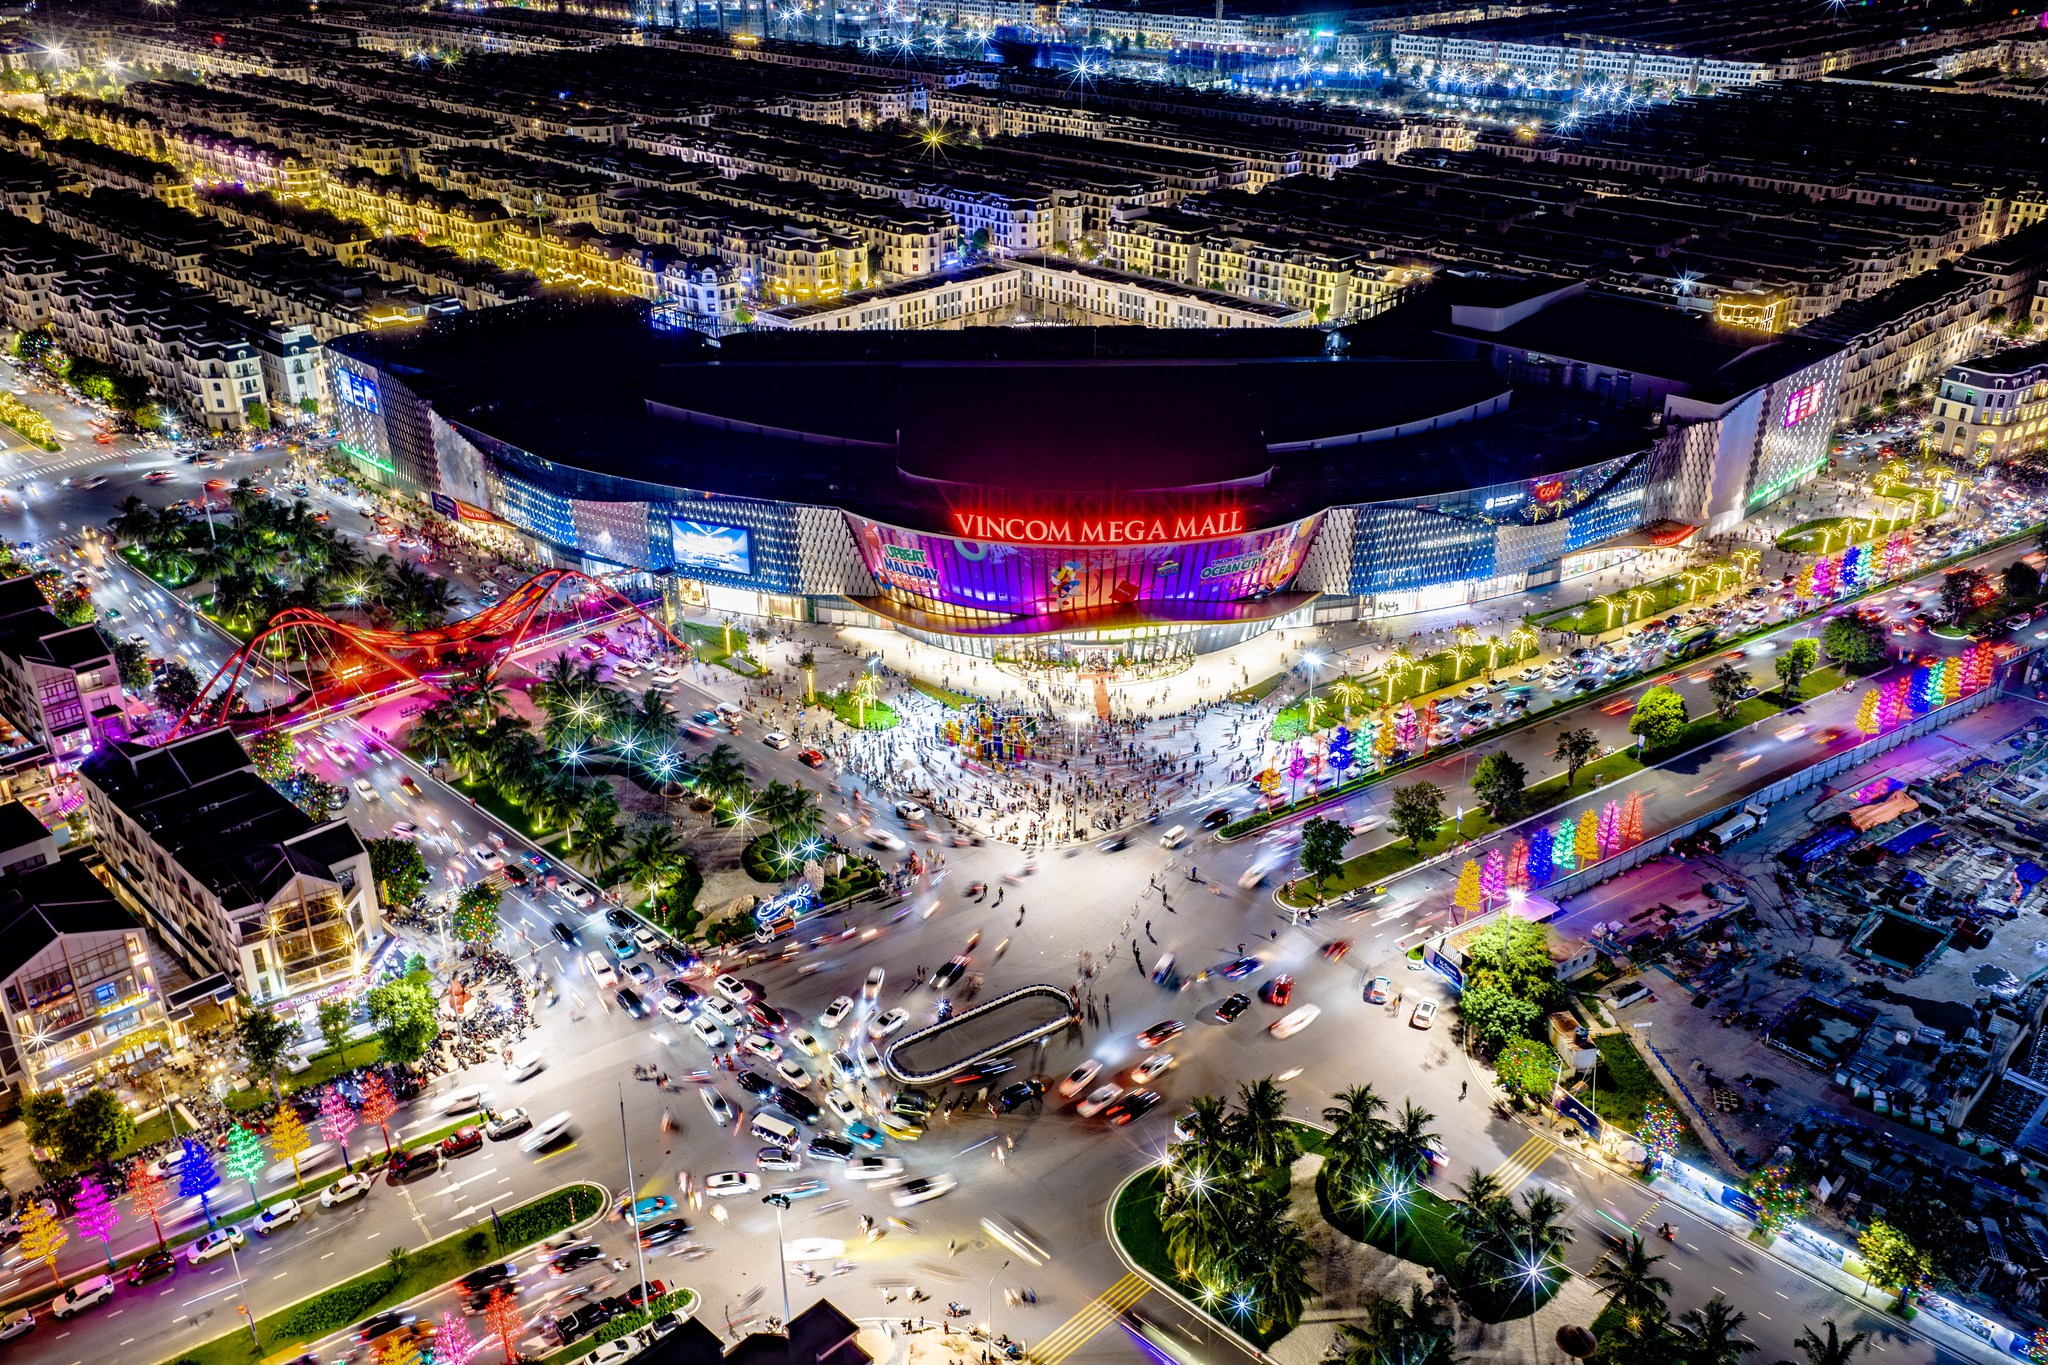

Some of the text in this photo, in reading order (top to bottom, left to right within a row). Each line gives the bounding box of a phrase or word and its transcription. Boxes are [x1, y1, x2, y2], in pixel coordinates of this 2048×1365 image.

[1540, 486, 1558, 497] CGV
[955, 510, 1242, 542] VINCOM MEGA MALL
[884, 544, 926, 563] UPBEAT
[884, 557, 938, 580] MALLIDAY
[1201, 562, 1241, 579] OCEAN
[1240, 555, 1264, 571] CITY
